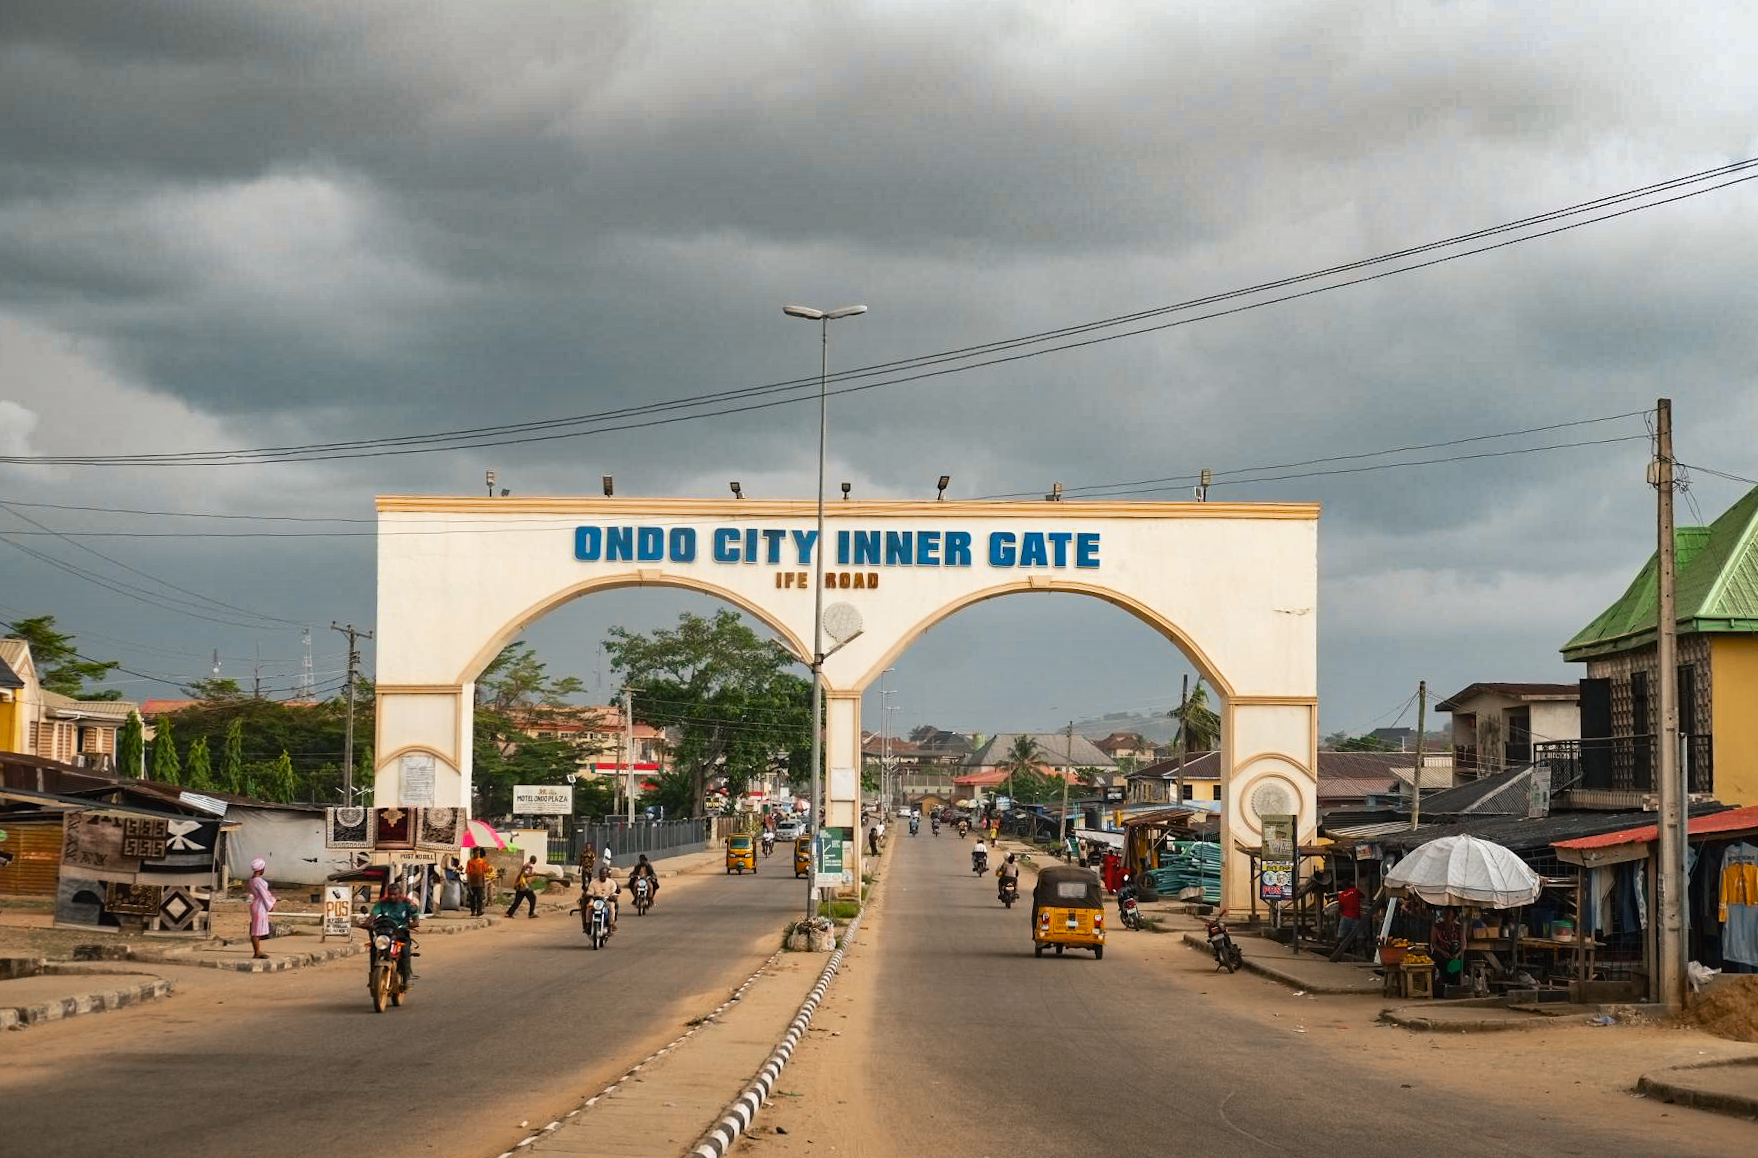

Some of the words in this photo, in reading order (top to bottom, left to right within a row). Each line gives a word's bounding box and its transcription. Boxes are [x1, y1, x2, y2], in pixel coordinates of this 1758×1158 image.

[574, 525, 697, 563] ONDO
[712, 527, 819, 566] CITY
[836, 530, 972, 568] INNER
[987, 531, 1101, 569] GATE
[775, 571, 808, 589] IFE
[824, 572, 879, 589] ROAD
[326, 900, 349, 917] POS
